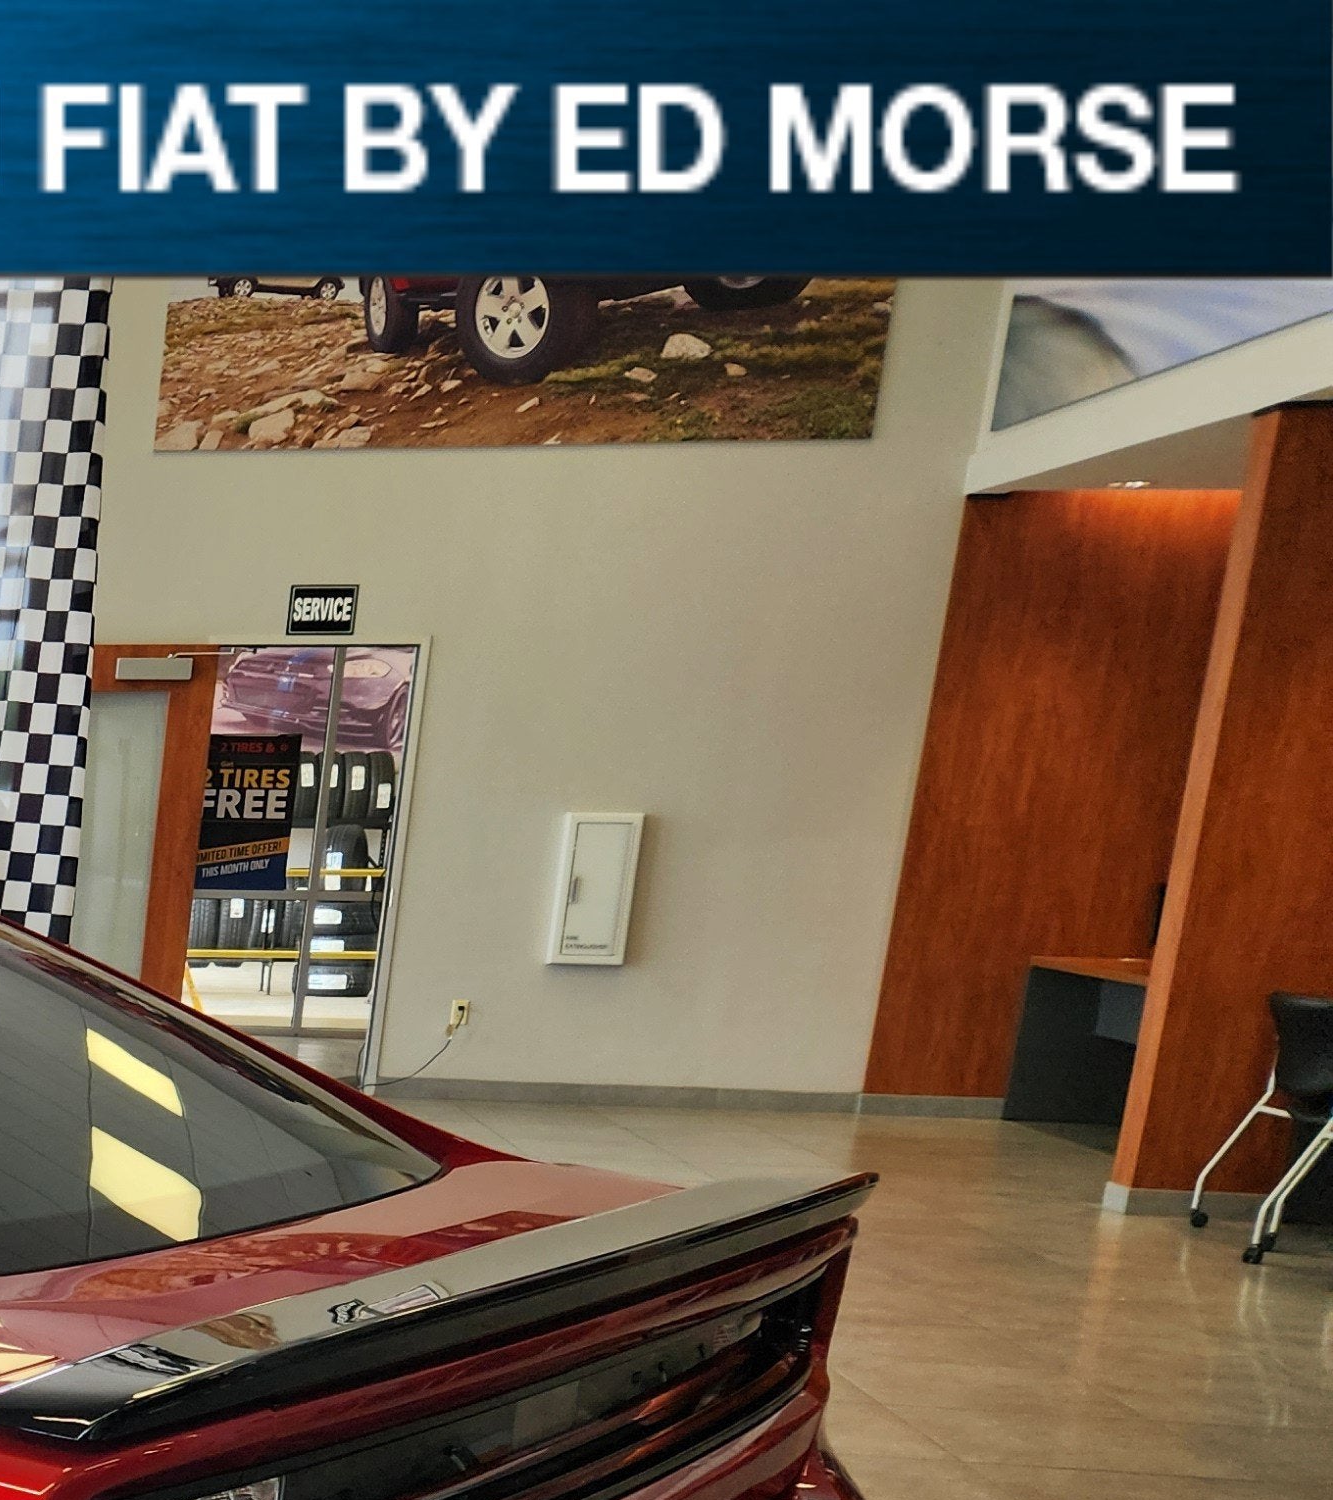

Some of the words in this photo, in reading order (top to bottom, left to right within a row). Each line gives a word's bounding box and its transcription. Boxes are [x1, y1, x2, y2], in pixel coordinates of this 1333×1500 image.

[293, 597, 353, 622] SERVICE
[219, 768, 290, 788] TIRES
[202, 788, 288, 819] FREE
[197, 849, 227, 862] IMITED
[229, 845, 250, 857] TIME
[252, 841, 282, 854] OFFER!
[201, 866, 219, 878] THIS
[219, 861, 249, 875] MONTH
[249, 858, 270, 870] ONLY
